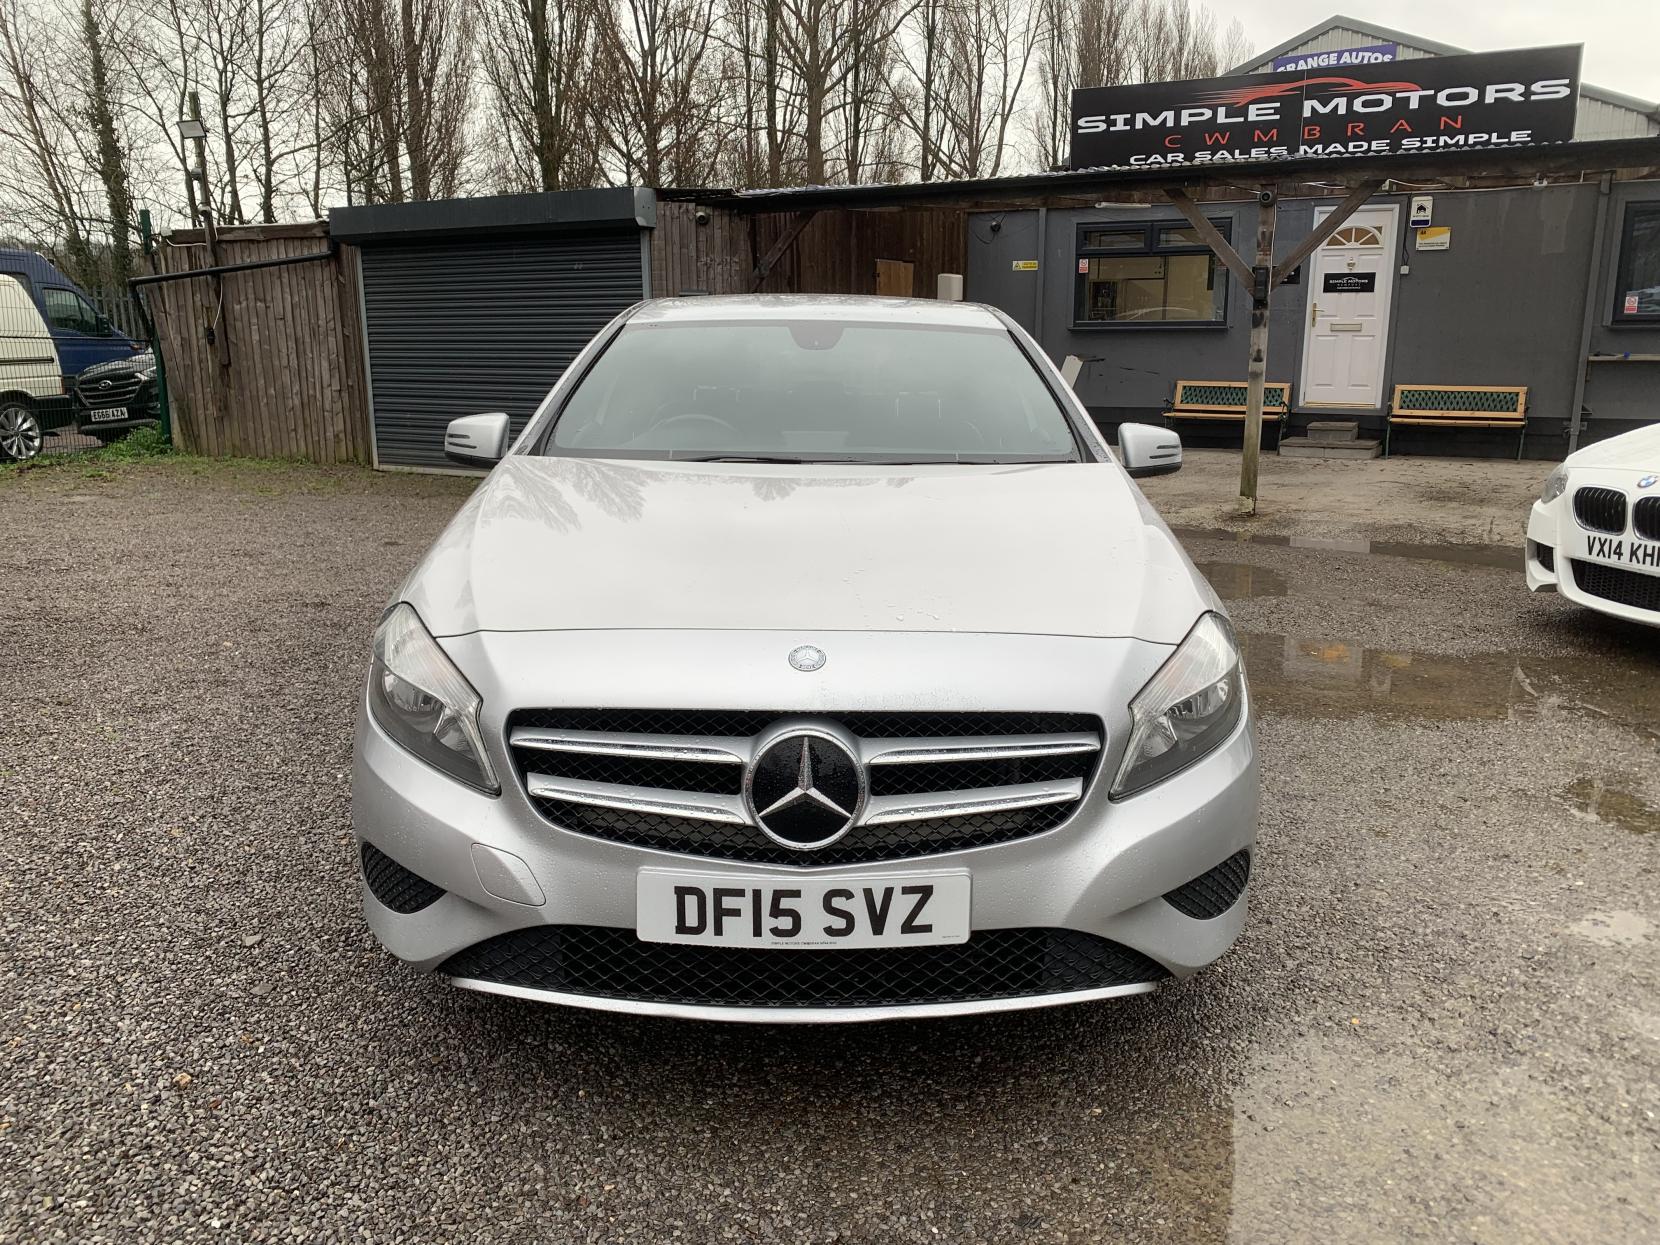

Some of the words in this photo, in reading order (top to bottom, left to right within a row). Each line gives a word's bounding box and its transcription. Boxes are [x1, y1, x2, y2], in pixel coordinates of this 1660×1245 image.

[1340, 51, 1393, 65] AUTOS
[1077, 102, 1281, 134] SIMPLE
[1303, 79, 1571, 117] MOTORS
[1129, 152, 1186, 165] CAR
[1194, 146, 1289, 161] SALES
[1300, 139, 1391, 155] MADE
[1401, 130, 1532, 149] SIMPLE
[1164, 115, 1463, 148] CWMBRAN
[1587, 535, 1624, 560] VX14
[674, 886, 802, 938] DF15
[822, 885, 934, 938] SVZ
